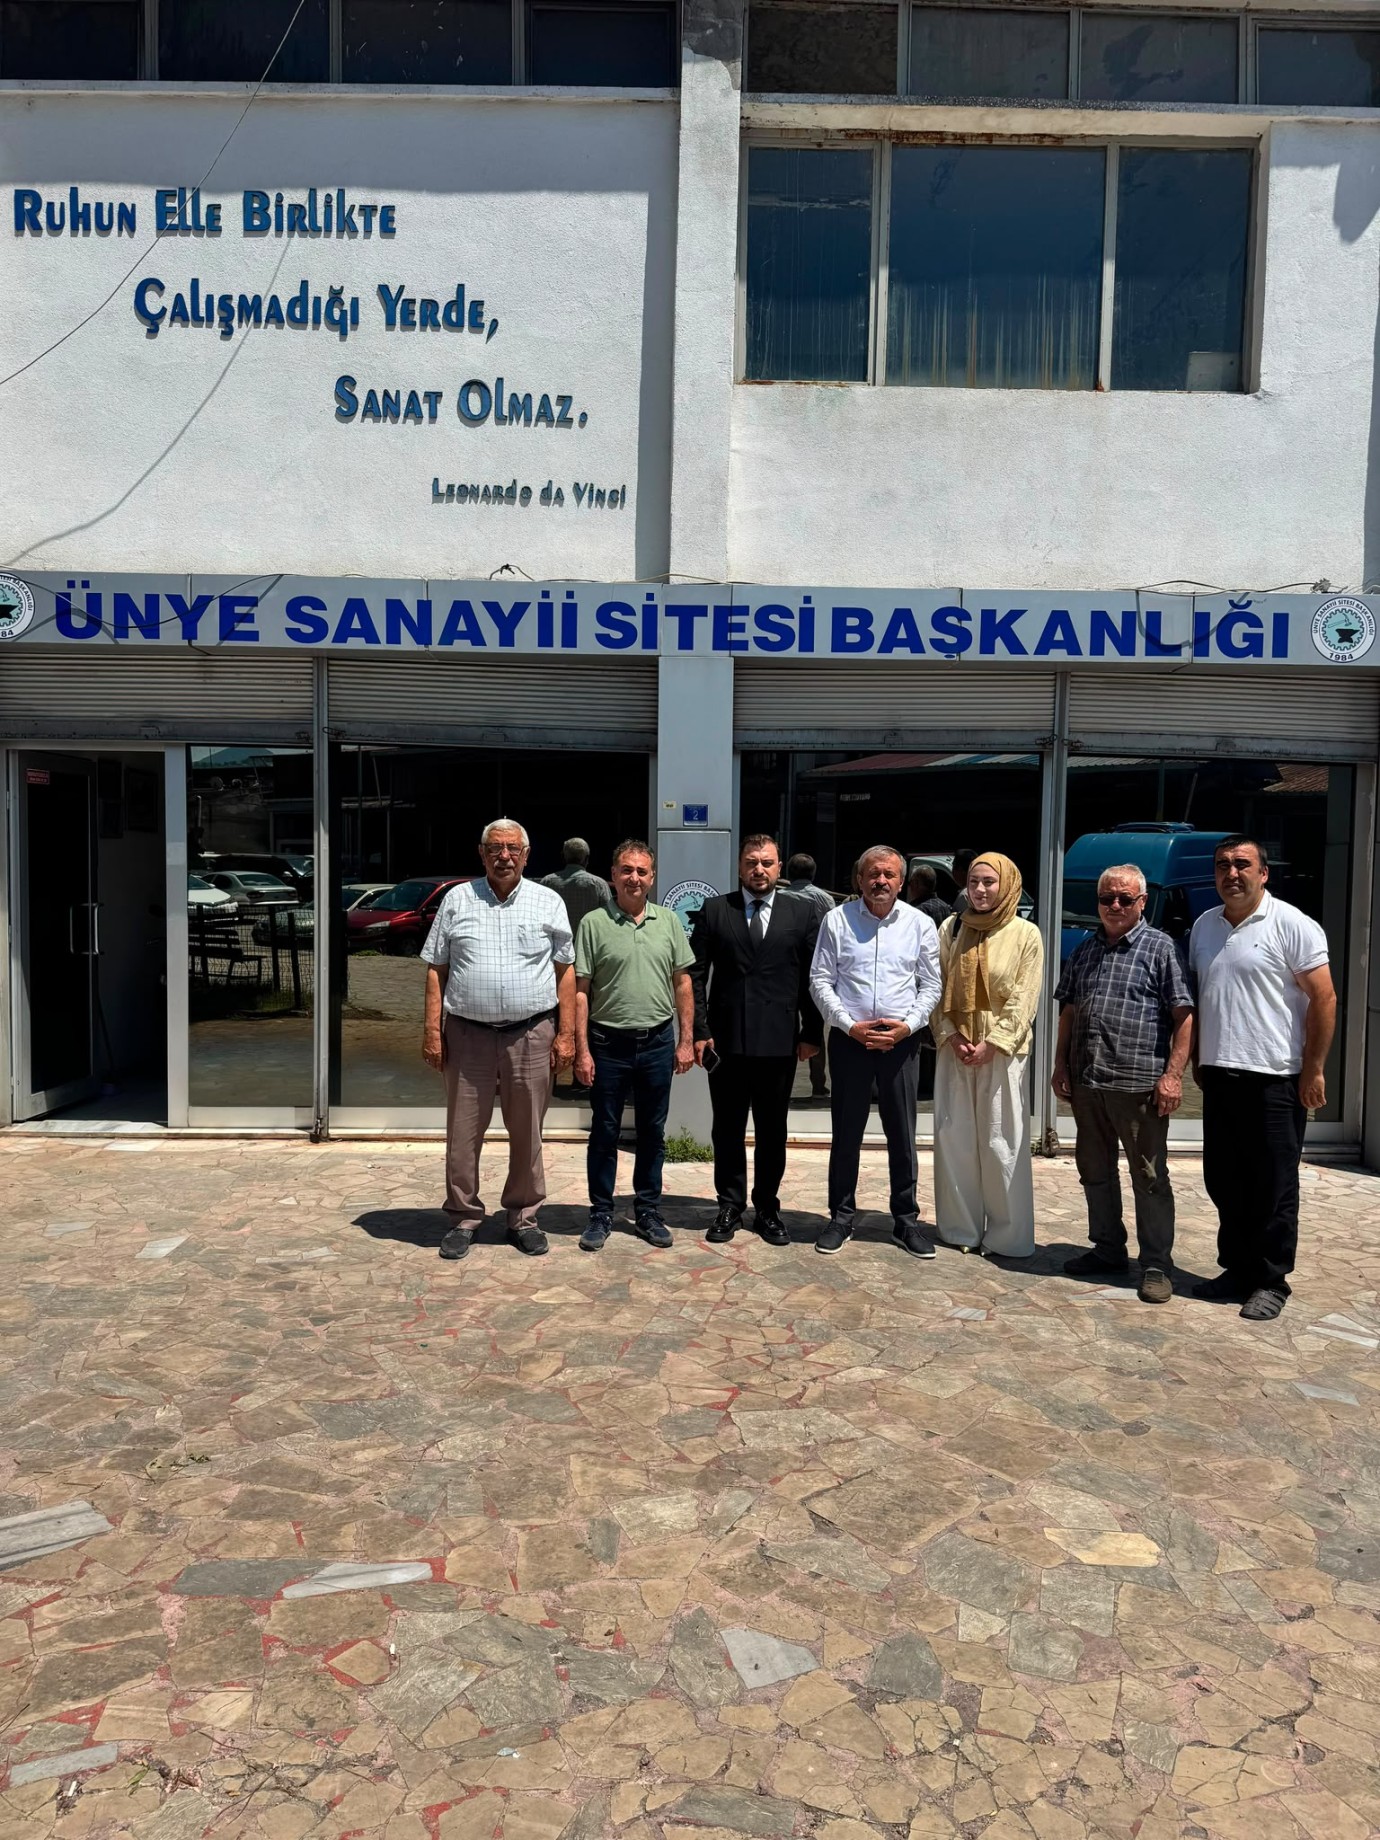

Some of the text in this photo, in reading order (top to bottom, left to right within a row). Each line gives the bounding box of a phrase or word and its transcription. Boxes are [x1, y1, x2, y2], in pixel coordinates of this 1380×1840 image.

[56, 580, 1290, 660] ÜNYE SANAYİİ SİTESİ BAŞKANLIĞI
[0, 629, 14, 637] 84
[1329, 653, 1353, 661] 1984
[692, 810, 699, 820] 2
